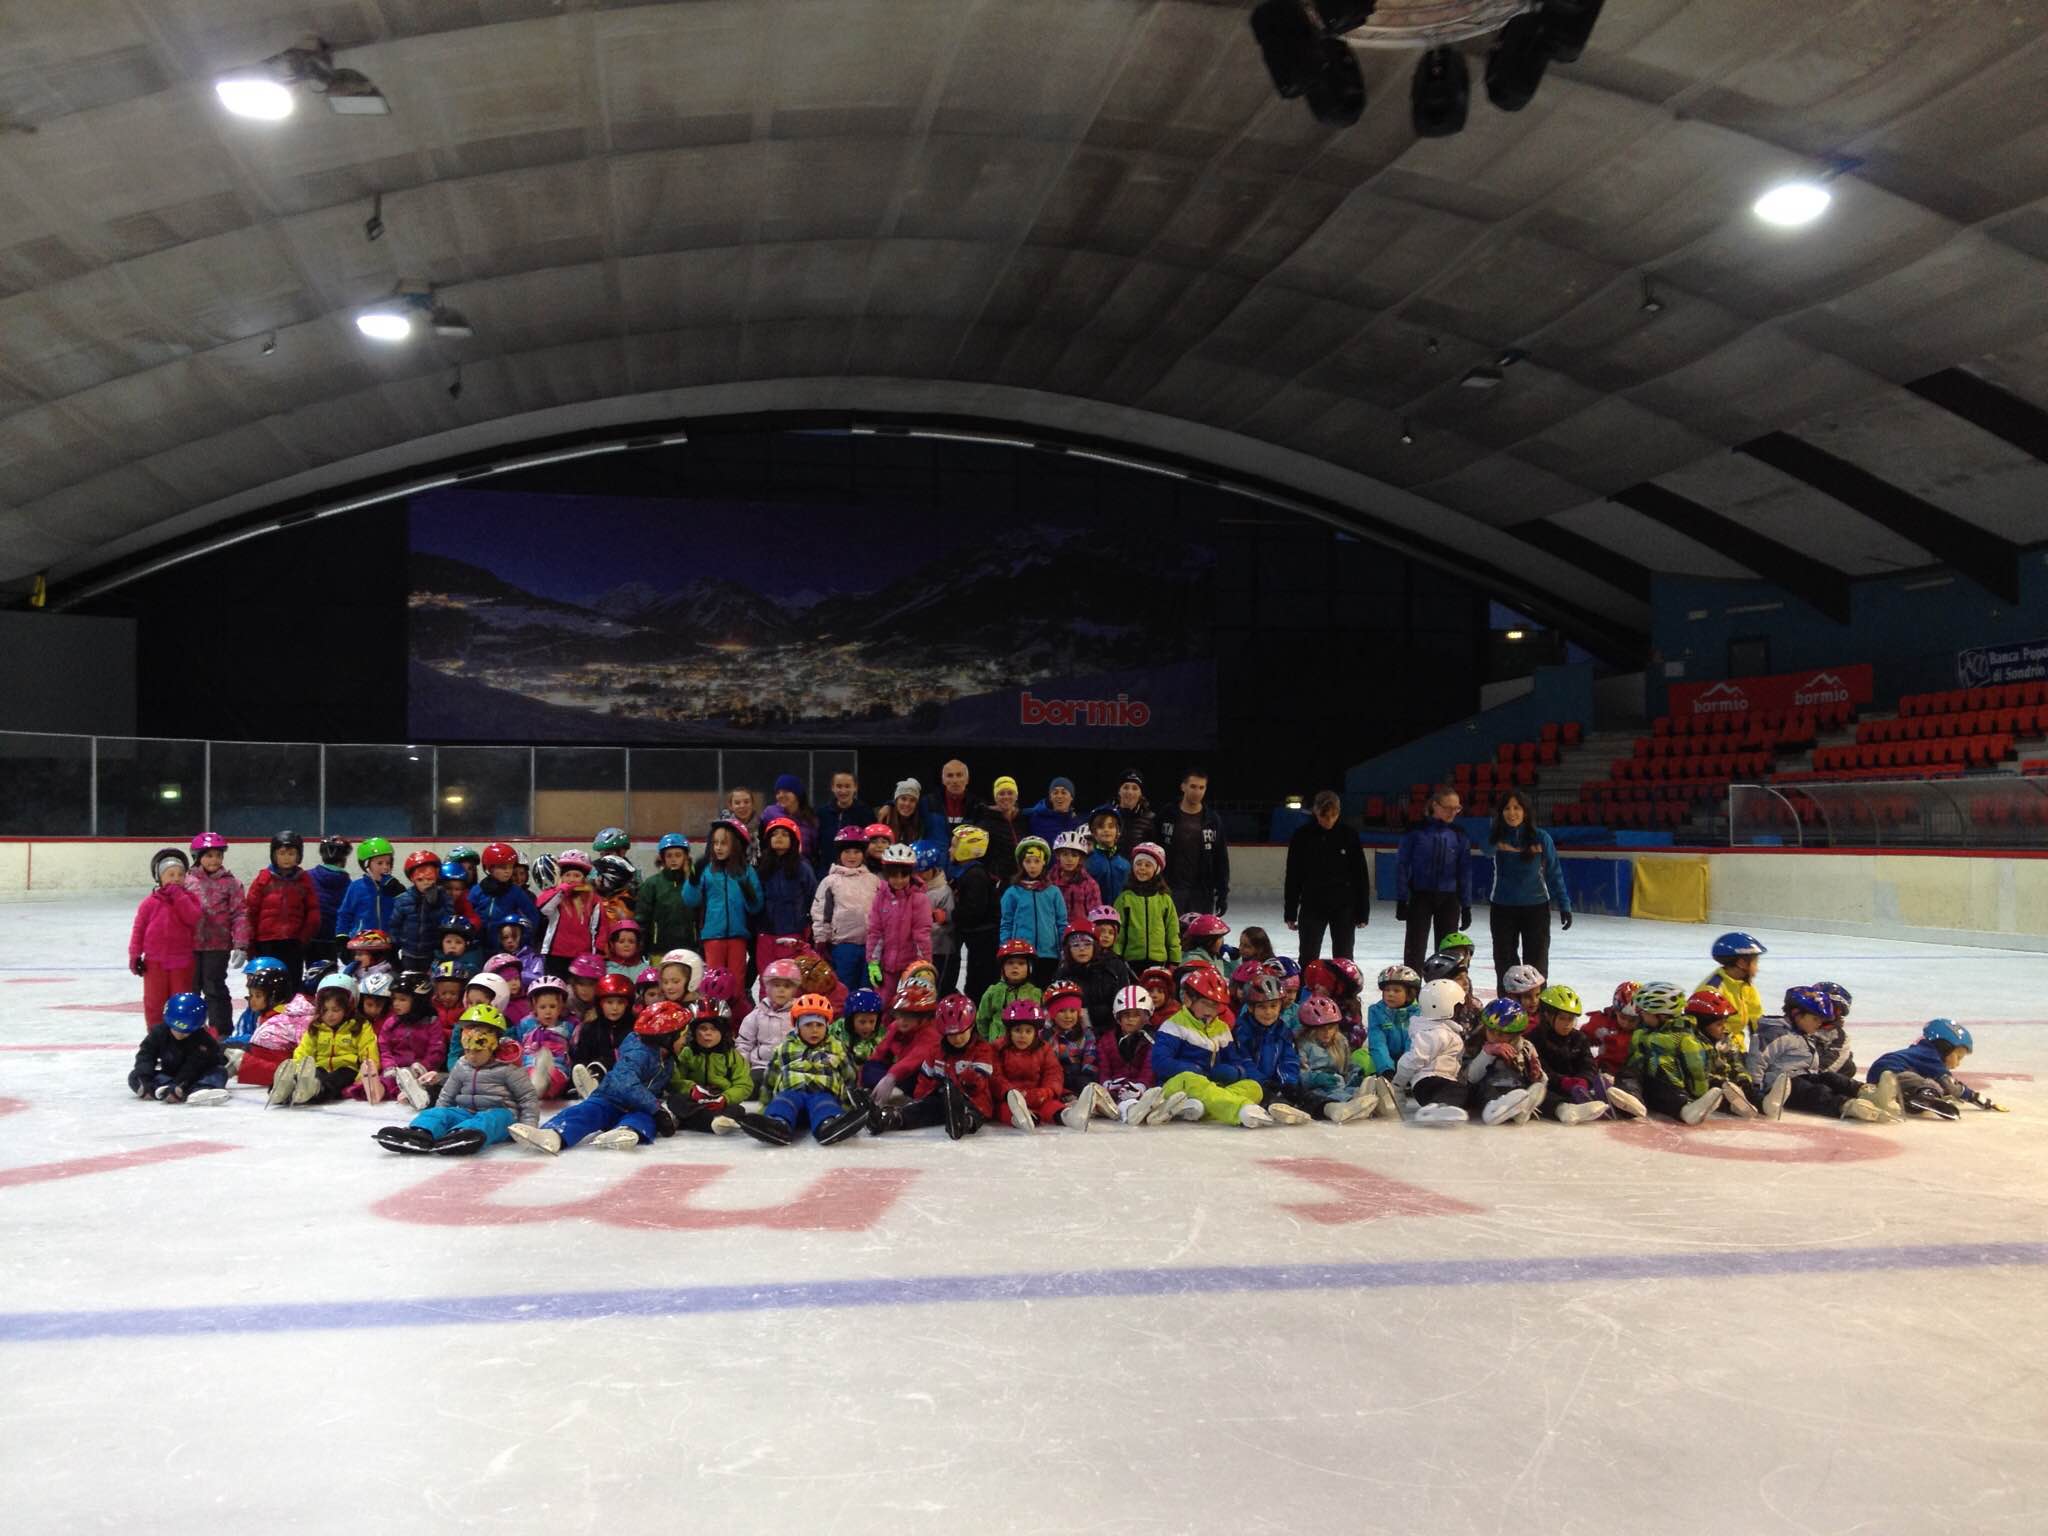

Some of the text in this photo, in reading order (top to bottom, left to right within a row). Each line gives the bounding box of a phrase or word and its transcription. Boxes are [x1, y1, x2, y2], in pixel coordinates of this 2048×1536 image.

[1989, 651, 2019, 664] Banca
[2006, 664, 2046, 681] Sondrio
[1693, 695, 1749, 714] bormio
[1794, 686, 1849, 706] bormio
[1020, 691, 1151, 728] bormio
